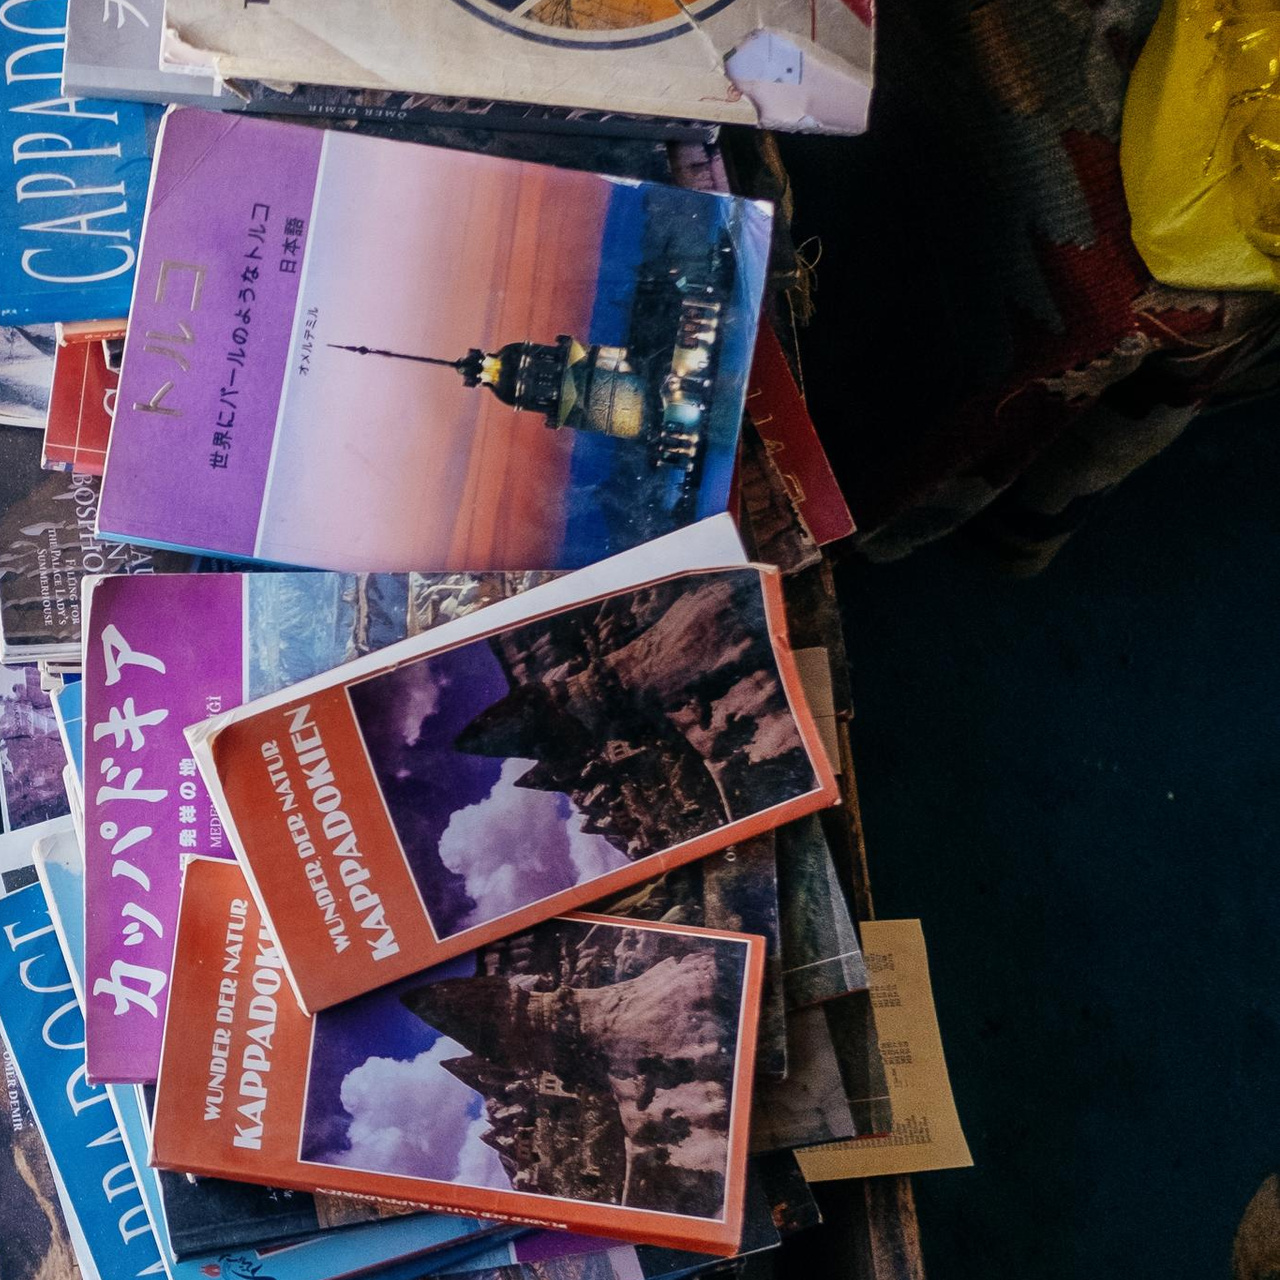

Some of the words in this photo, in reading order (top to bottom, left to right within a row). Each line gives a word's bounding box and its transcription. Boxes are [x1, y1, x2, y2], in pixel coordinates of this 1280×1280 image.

[279, 216, 305, 274] 日本語
[132, 259, 207, 418] トルコ
[72, 472, 105, 573] BOSPHO
[70, 604, 80, 625] FOR
[261, 739, 299, 812] NATUR
[92, 623, 169, 1018] カッパドキア
[283, 703, 400, 961] KAPPADOKIEN
[286, 812, 316, 859] DER
[222, 898, 249, 974] NATUR
[304, 860, 351, 954] WUNDER
[216, 977, 238, 1023] DER
[204, 1027, 232, 1121] WUNDER
